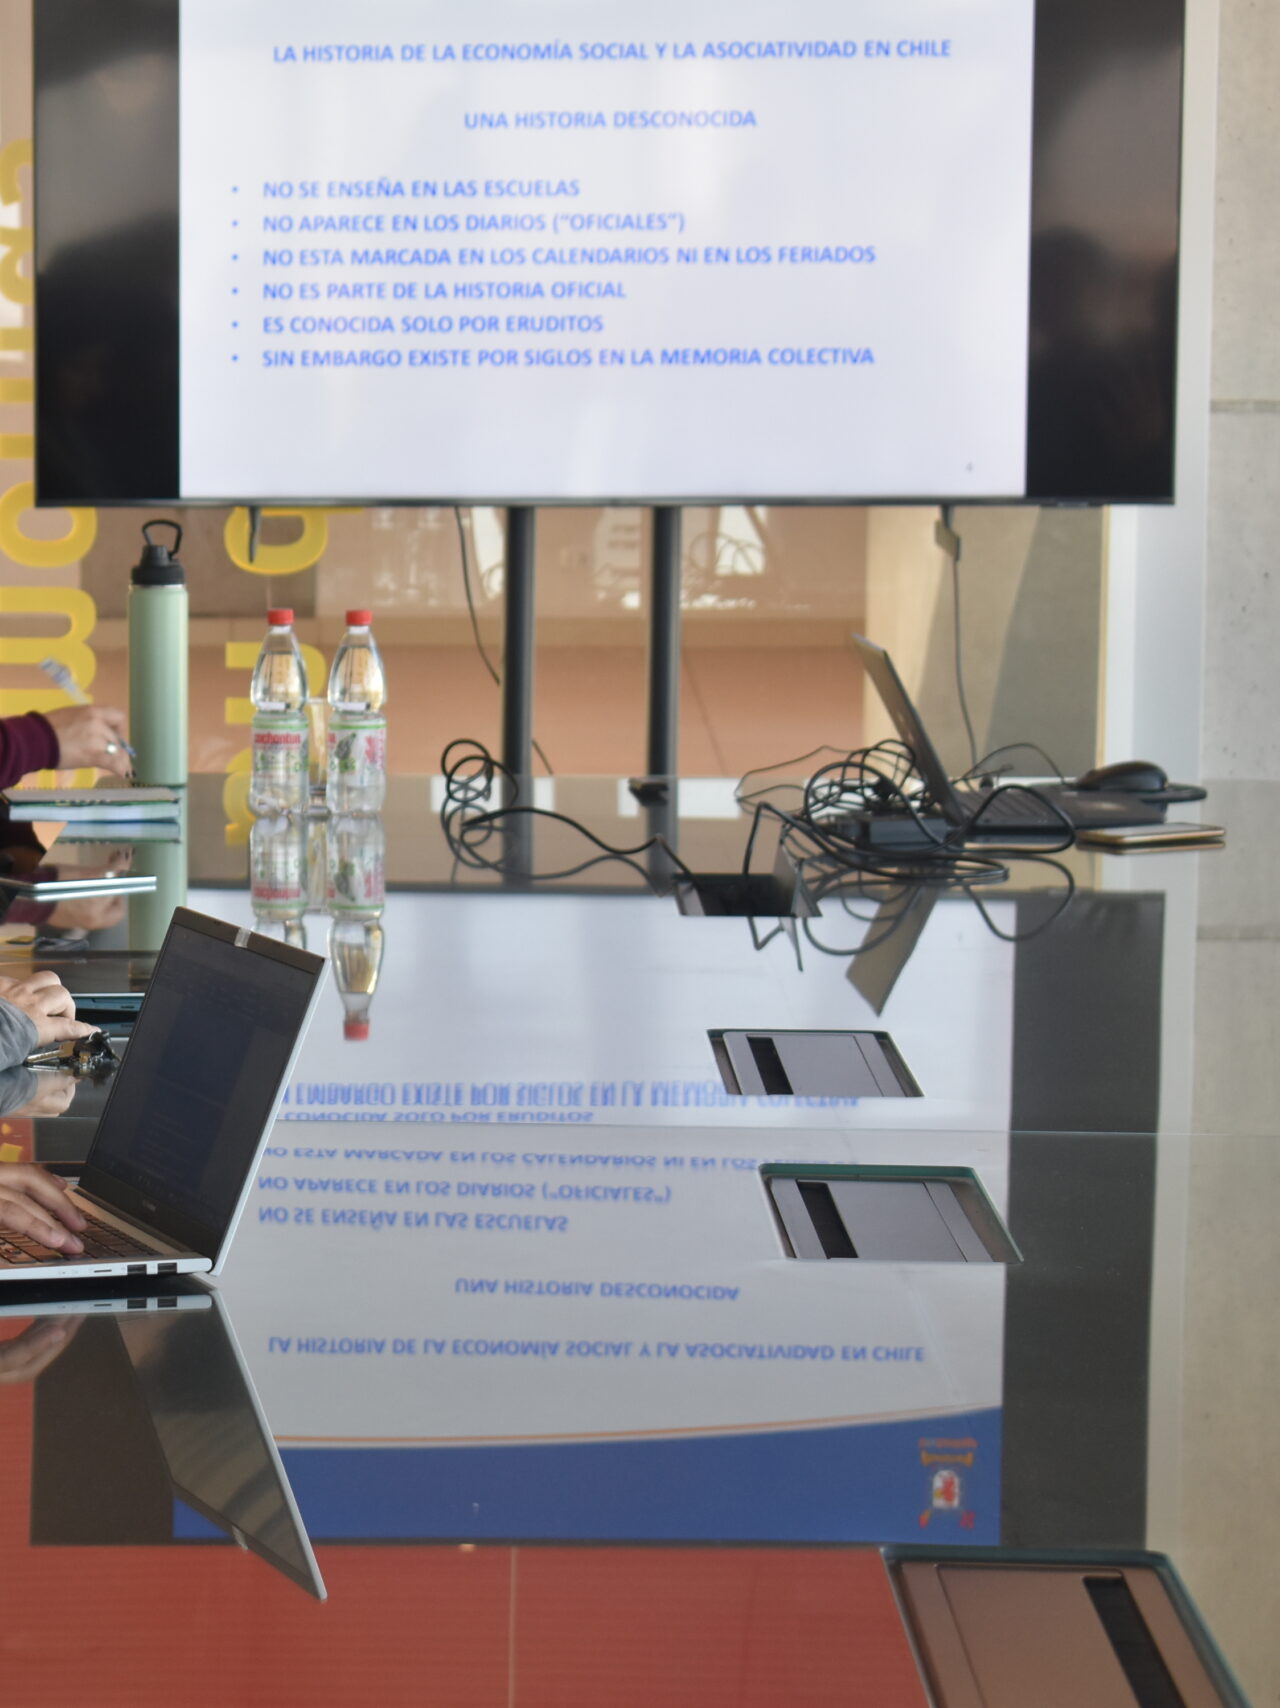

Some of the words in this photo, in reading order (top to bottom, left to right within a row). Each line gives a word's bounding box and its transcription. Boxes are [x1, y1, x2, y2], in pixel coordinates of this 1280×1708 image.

[274, 46, 297, 62] LA
[303, 45, 395, 62] HISTORIA
[401, 45, 425, 62] DE
[432, 45, 457, 61] LA
[462, 42, 573, 61] ECONOMÍA
[579, 42, 649, 60] SOCIAL
[656, 44, 668, 58] Y
[673, 43, 697, 59] LA
[703, 41, 858, 59] ASOCIATIVIDAD
[864, 41, 891, 57] EN
[896, 40, 950, 57] CHILE
[464, 112, 509, 129] UNA
[515, 112, 607, 128] HISTORIA
[614, 111, 757, 128] DESCONOCIDA
[263, 181, 294, 199] NO
[299, 181, 319, 199] SE
[327, 178, 406, 198] ENSEÑA
[411, 181, 438, 198] EN
[444, 181, 478, 197] LAS
[484, 180, 581, 197] ESCUELAS
[263, 216, 294, 232] NO
[299, 215, 384, 232] APARECE
[392, 215, 418, 232] EN
[424, 215, 461, 232] LOS
[466, 215, 547, 231] DIARIOS
[263, 249, 295, 267] NO
[300, 249, 344, 265] ESTA
[351, 249, 452, 265] MARCADA
[459, 249, 485, 265] EN
[490, 248, 527, 265] LOS
[532, 248, 670, 265] CALENDARIOS
[677, 248, 698, 264] NI
[703, 248, 731, 264] EN
[736, 247, 773, 264] LOS
[778, 246, 877, 264] FERIADOS
[263, 283, 294, 300] NO
[299, 283, 321, 300] ES
[327, 282, 385, 299] PARTE
[393, 282, 417, 299] DE
[424, 283, 448, 299] LA
[454, 282, 545, 299] HISTORIA
[551, 281, 624, 299] OFICIAL
[263, 317, 285, 335] ES
[289, 317, 396, 334] CONOCIDA
[401, 316, 454, 334] SOLO
[459, 316, 500, 333] POR
[506, 315, 605, 333] ERUDITOS
[262, 351, 295, 367] SIN
[301, 350, 403, 367] EMBARGO
[408, 349, 470, 367] EXISTE
[478, 349, 519, 366] POR
[524, 349, 593, 367] SIGLOS
[599, 349, 626, 365] EN
[631, 350, 654, 366] LA
[661, 349, 763, 365] MEMORIA
[768, 348, 875, 366] COLECTIVA
